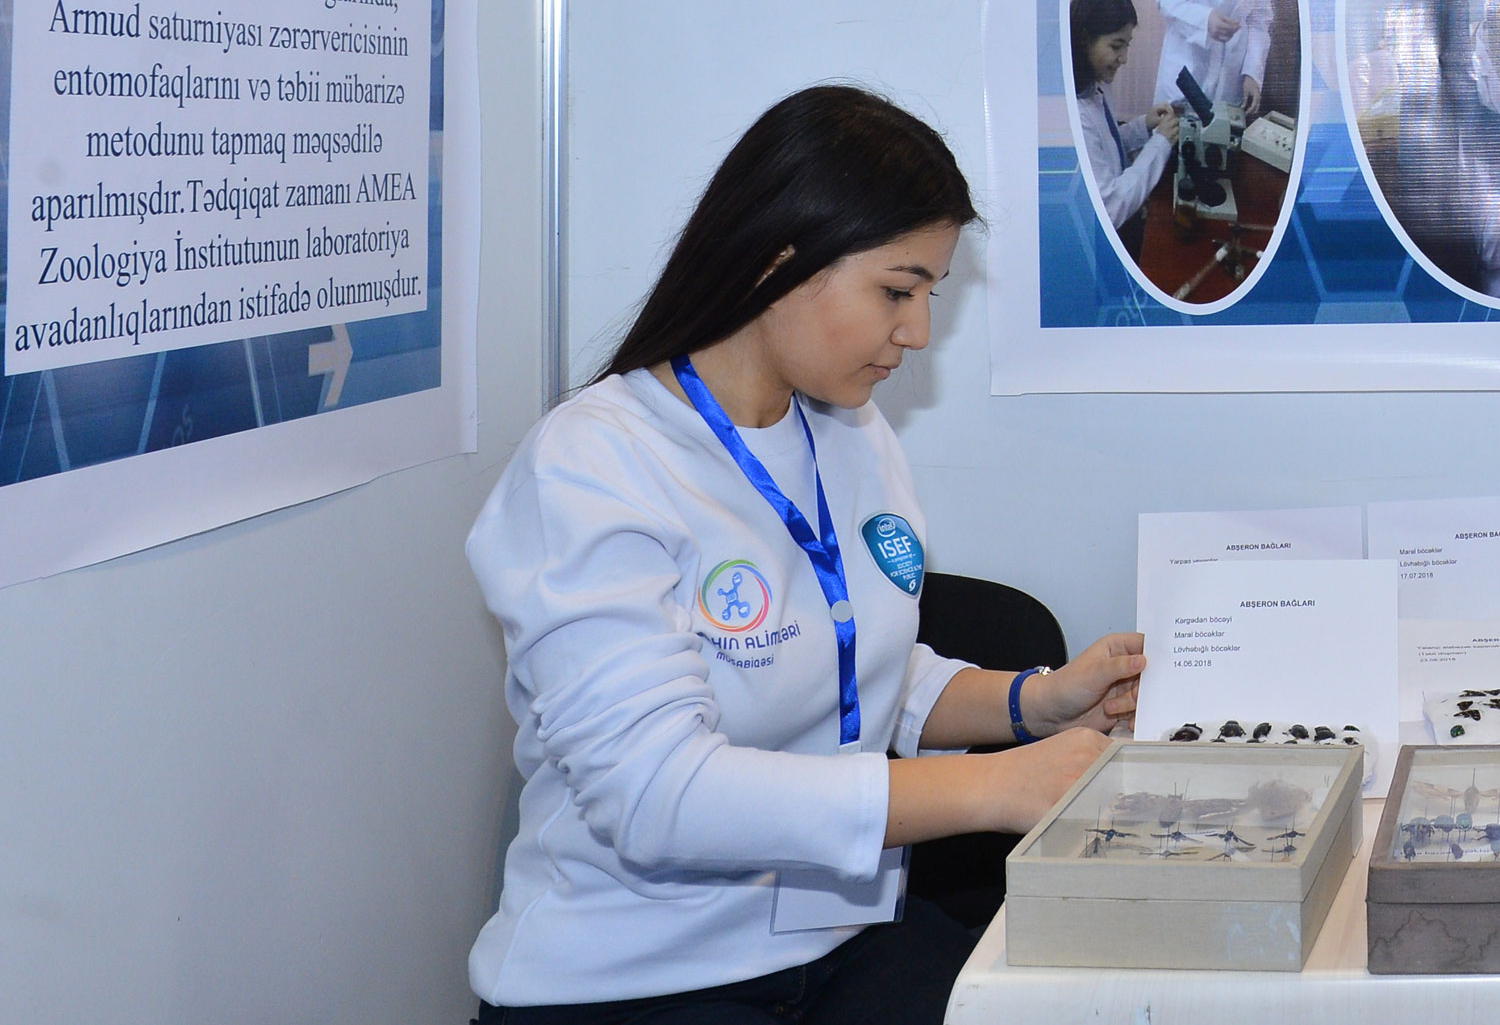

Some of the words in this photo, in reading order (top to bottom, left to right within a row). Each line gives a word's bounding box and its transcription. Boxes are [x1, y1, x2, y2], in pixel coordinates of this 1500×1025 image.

[149, 11, 263, 53] saturniyası
[269, 23, 408, 56] zərərvericisinin
[54, 63, 240, 108] entomofaqlarını
[247, 79, 270, 101] və
[277, 71, 319, 102] təbii
[326, 73, 404, 104] mübarizə
[86, 121, 204, 157] metodunu
[211, 127, 286, 165] tapmaq
[293, 123, 382, 162] məqsədilə
[285, 184, 351, 207] zamanı
[356, 172, 416, 203] AMEA
[38, 240, 168, 287] Zoologiya
[174, 230, 300, 271] İnstitutunun
[306, 221, 409, 258] laboratoriya
[15, 292, 232, 351] avadanlıqlarından
[239, 281, 311, 320] istifadə
[317, 269, 421, 309] olunmuşdur.
[878, 536, 912, 559] ISEF
[1226, 543, 1259, 552] ABŞERON
[1261, 541, 1292, 550] BAĞLARI
[1455, 532, 1488, 540] ABŞERON
[1240, 600, 1278, 609] ABŞERON
[1280, 599, 1315, 608] BAĞLARI
[1174, 631, 1193, 639] Maral
[1174, 660, 1212, 668] 14.06.2018
